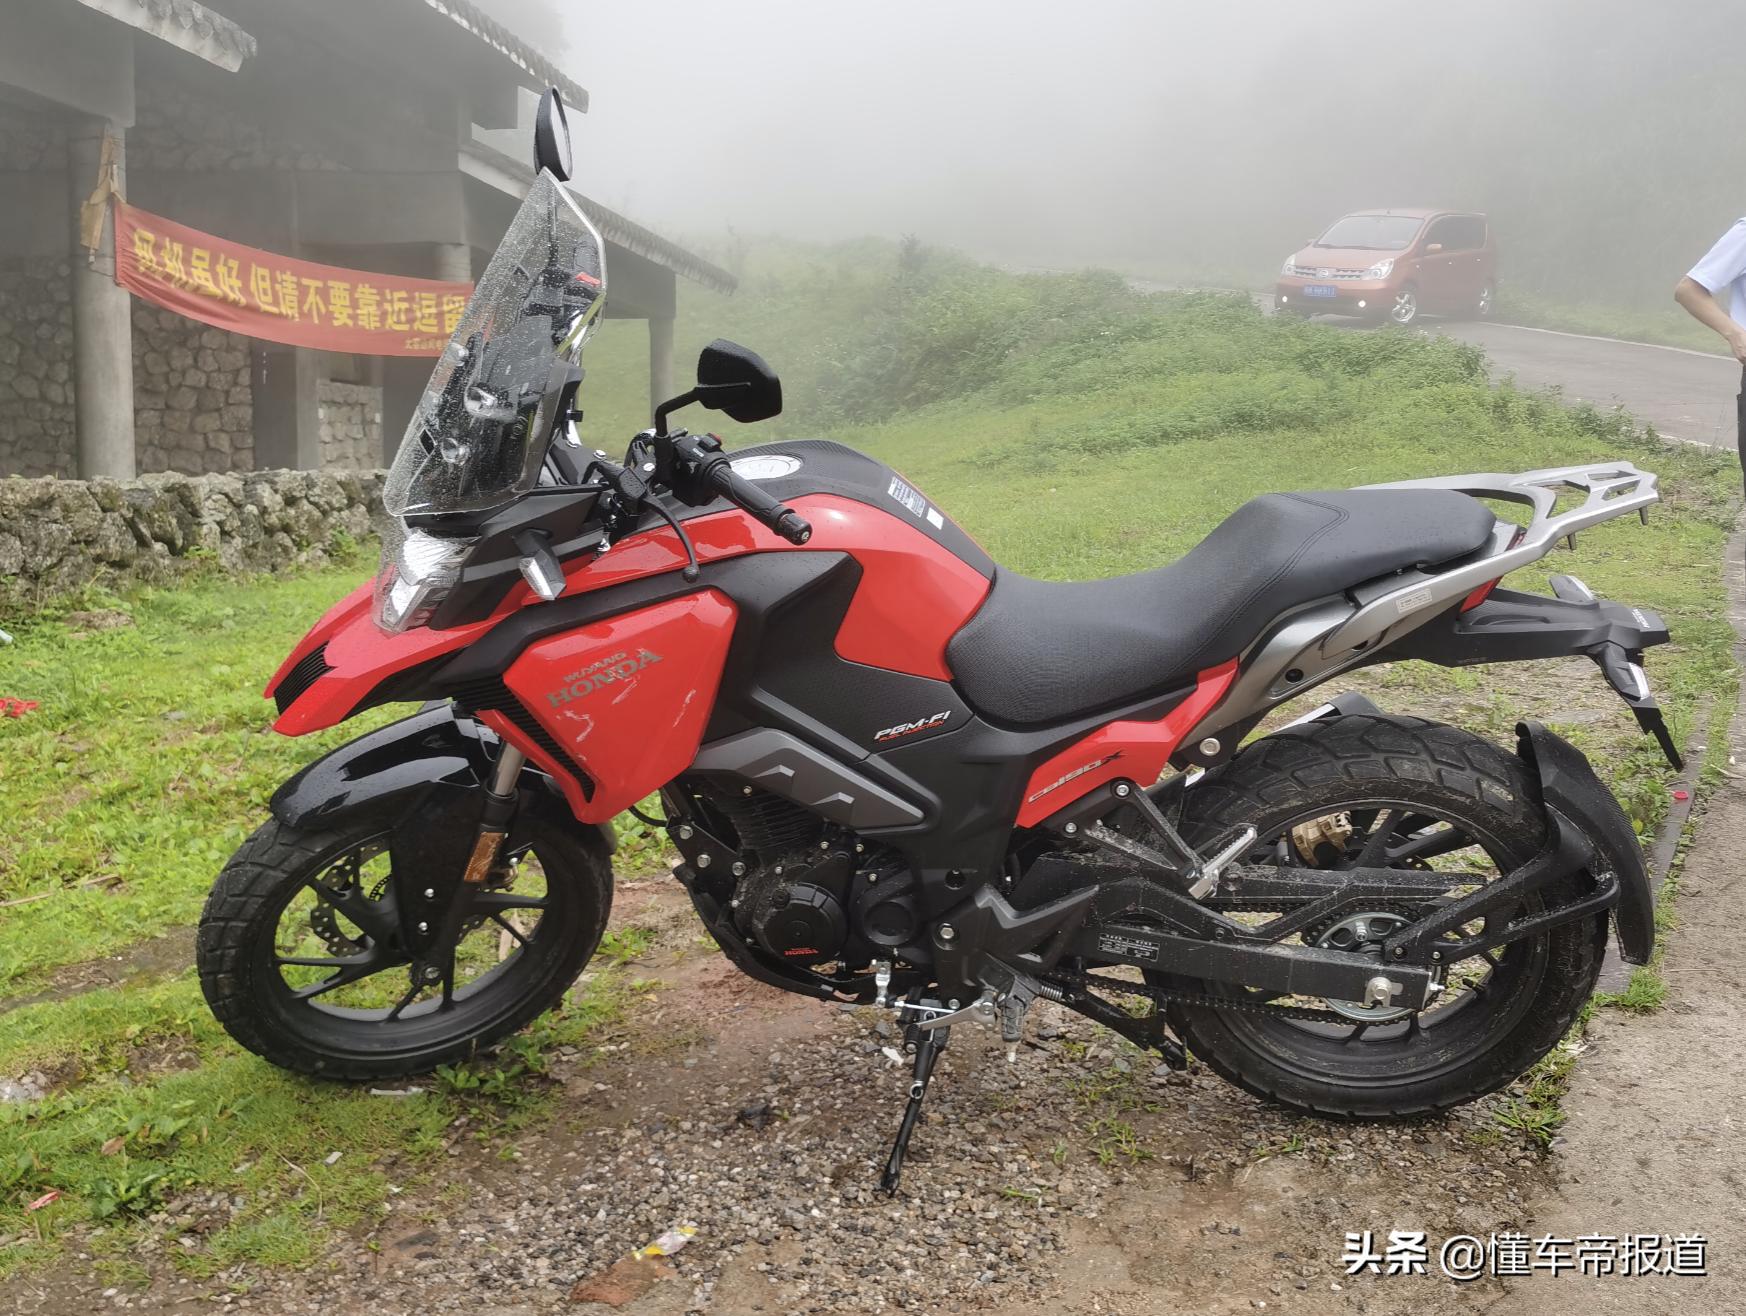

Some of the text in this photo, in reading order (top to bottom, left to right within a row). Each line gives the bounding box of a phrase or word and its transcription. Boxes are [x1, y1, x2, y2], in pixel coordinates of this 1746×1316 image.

[546, 649, 663, 708] HONDA
[563, 651, 627, 682] WUYANG
[874, 710, 951, 740] PGM-FI
